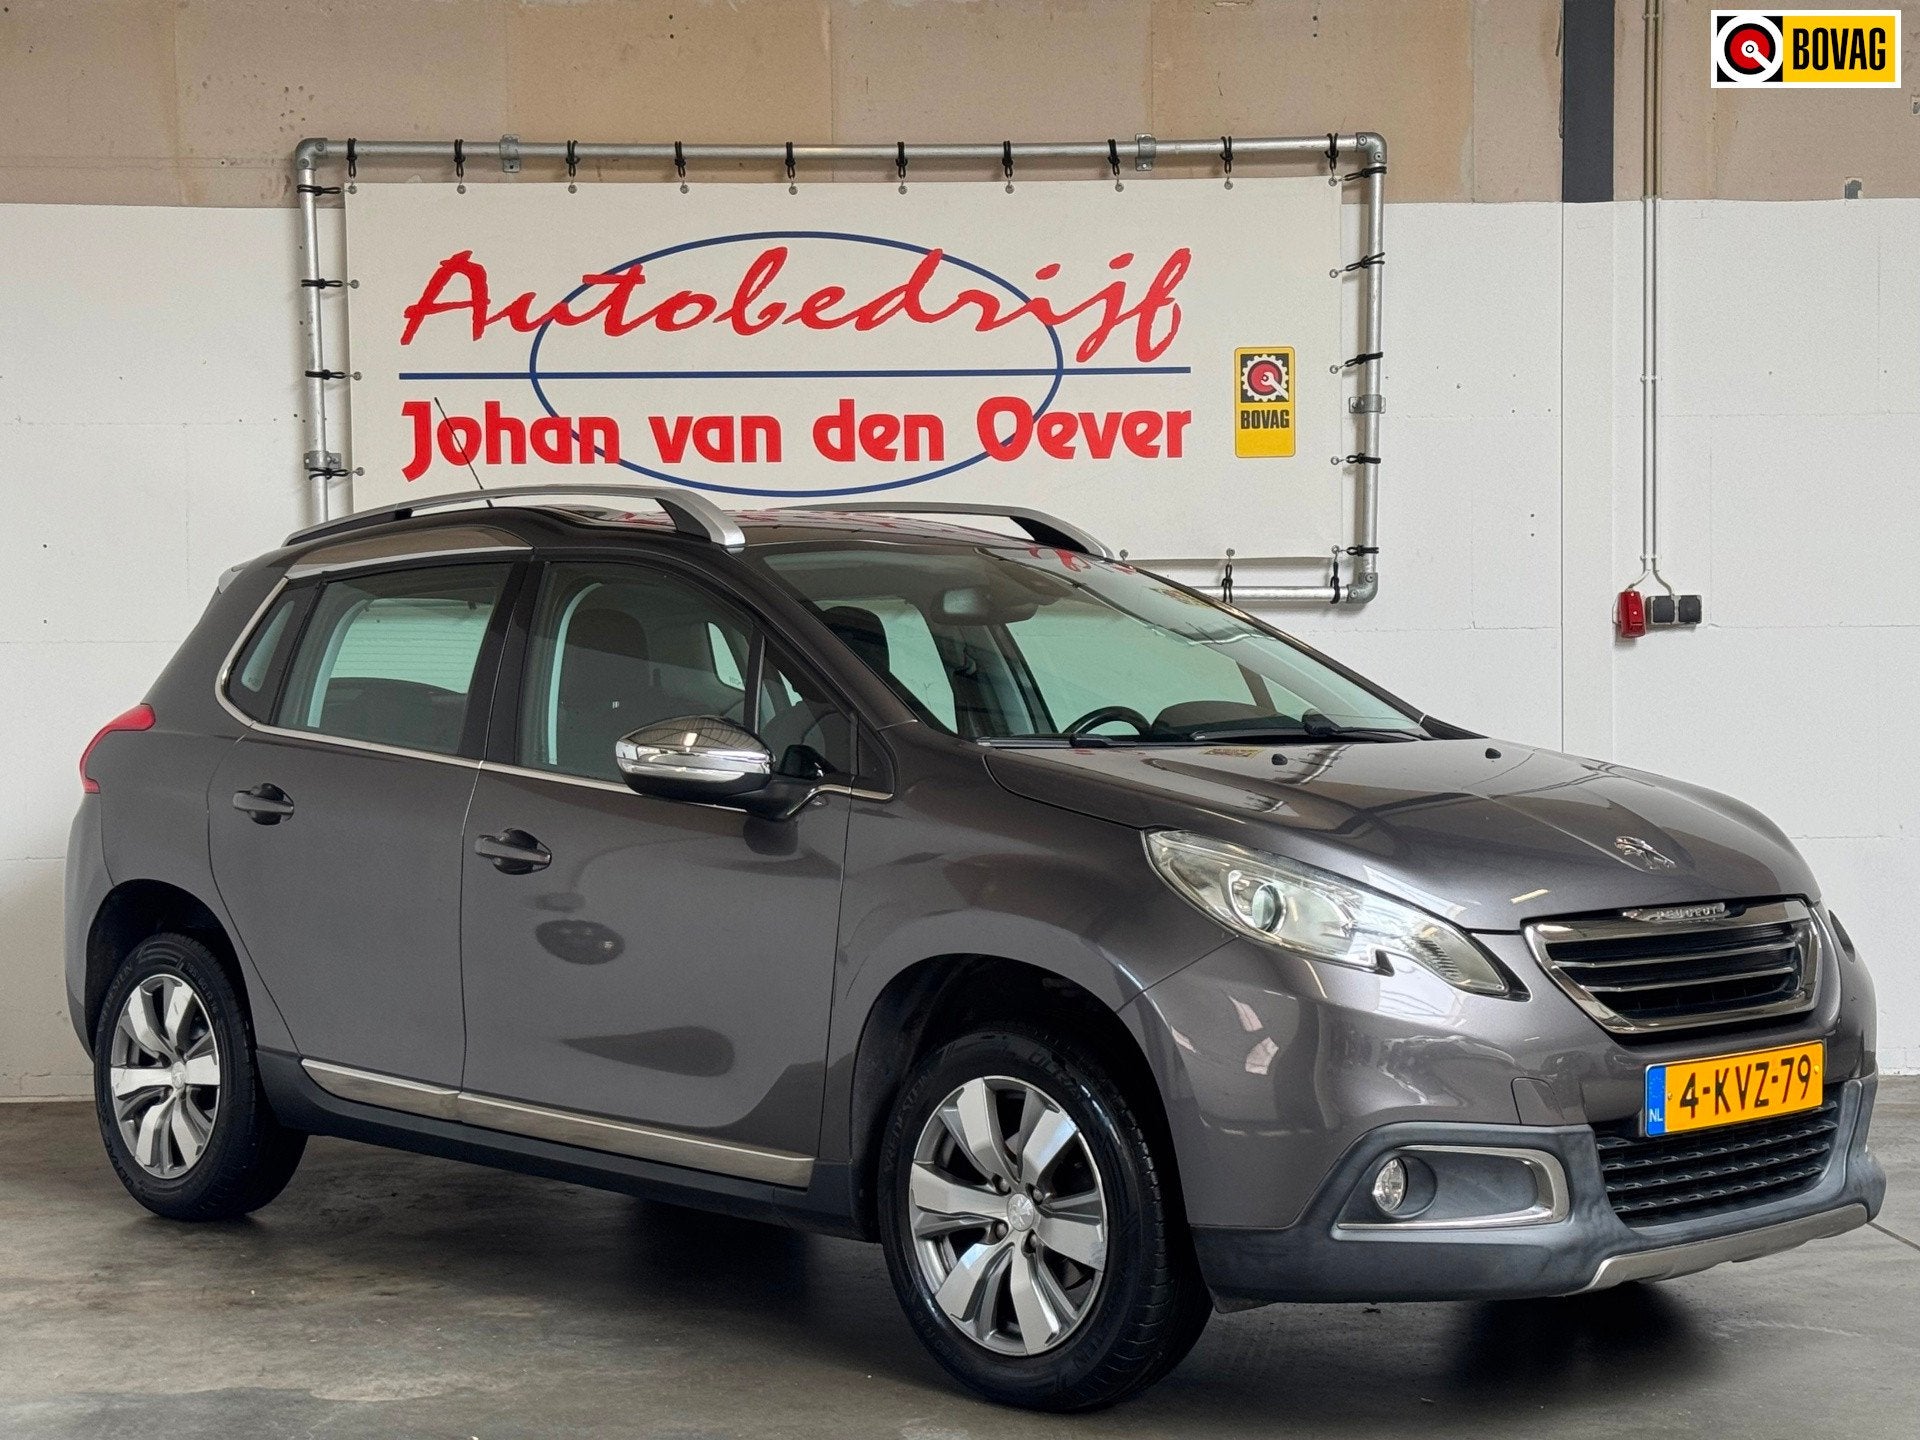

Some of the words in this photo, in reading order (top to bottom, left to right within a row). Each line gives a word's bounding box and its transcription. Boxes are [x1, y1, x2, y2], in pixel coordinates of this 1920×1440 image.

[400, 246, 1192, 363] Autobedrijf
[401, 400, 621, 482] Johan
[648, 415, 782, 465] van
[812, 398, 945, 462] den
[976, 396, 1192, 462] Oever
[1240, 409, 1290, 430] BOVAG
[1649, 1109, 1664, 1122] NL
[1679, 1053, 1812, 1119] 4-KVZ-79
